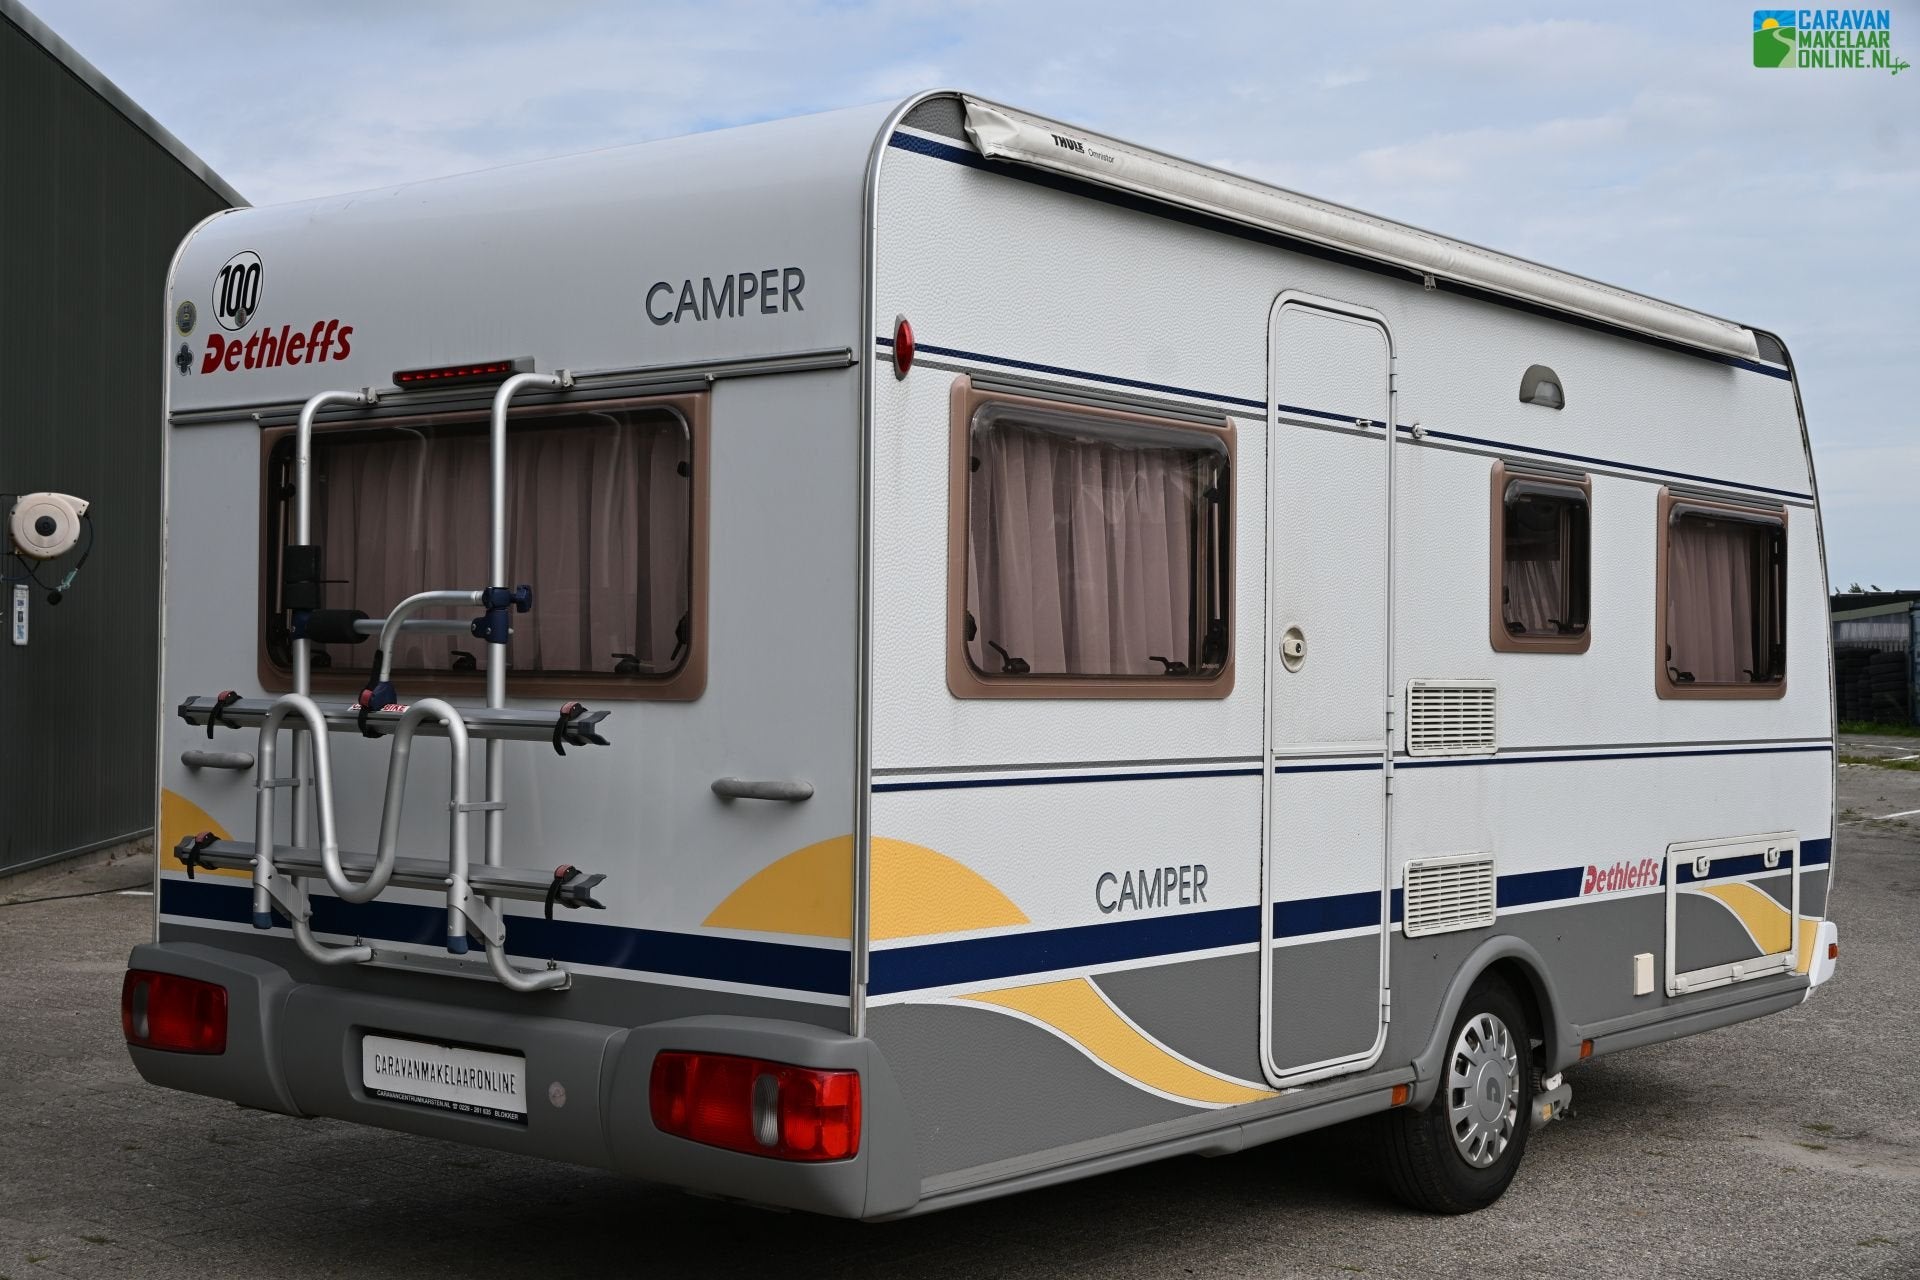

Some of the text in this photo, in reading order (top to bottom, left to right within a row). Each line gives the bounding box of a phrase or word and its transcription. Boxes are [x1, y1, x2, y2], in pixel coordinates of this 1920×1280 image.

[1051, 134, 1115, 164] THULE Omnistor
[219, 262, 261, 318] 100
[645, 266, 806, 326] CAMPER
[200, 318, 354, 375] Dethleffs
[1095, 864, 1208, 914] CAMPER
[1583, 857, 1660, 895] Dethleffs
[374, 1053, 517, 1095] CARAVANMAKELAARONLINE
[494, 1109, 519, 1121] BLOKKER
